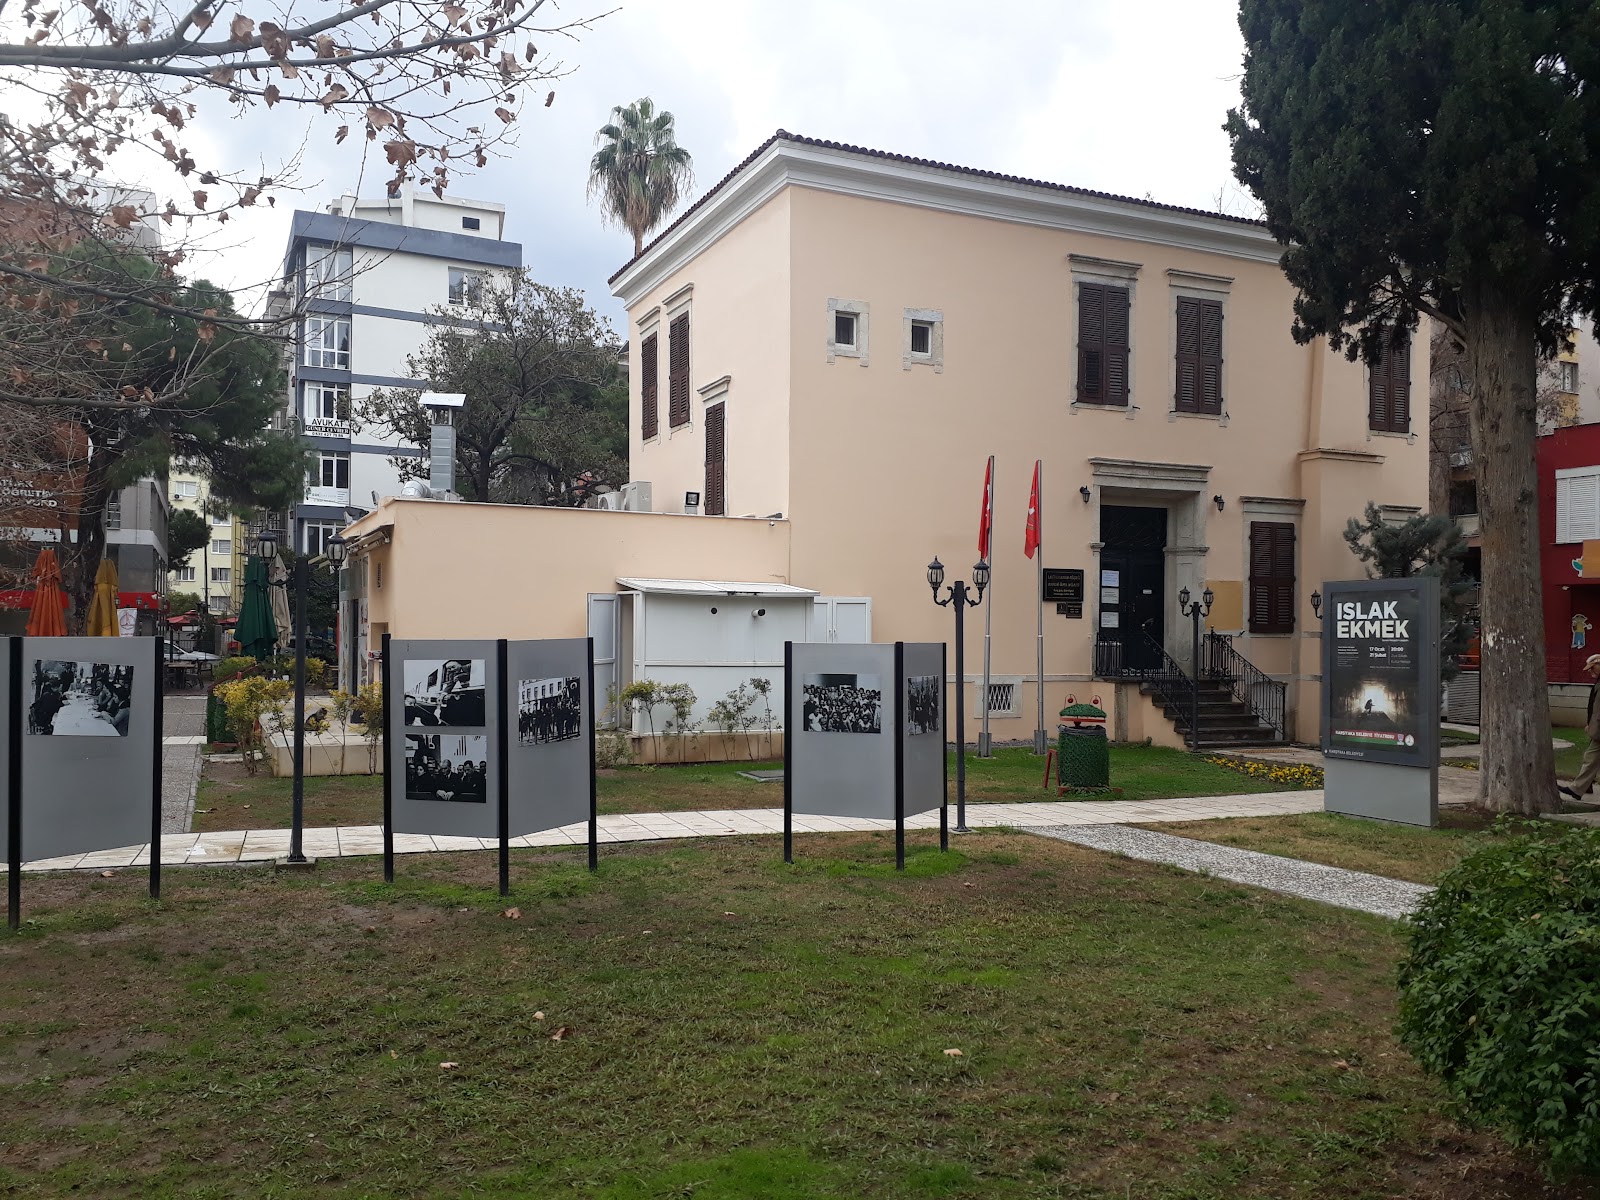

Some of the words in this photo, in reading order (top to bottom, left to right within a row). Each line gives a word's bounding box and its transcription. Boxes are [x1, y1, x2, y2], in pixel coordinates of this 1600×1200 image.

[311, 418, 344, 427] AVUKAT
[1336, 601, 1399, 620] ISLAK
[1336, 620, 1410, 639] EKMEK
